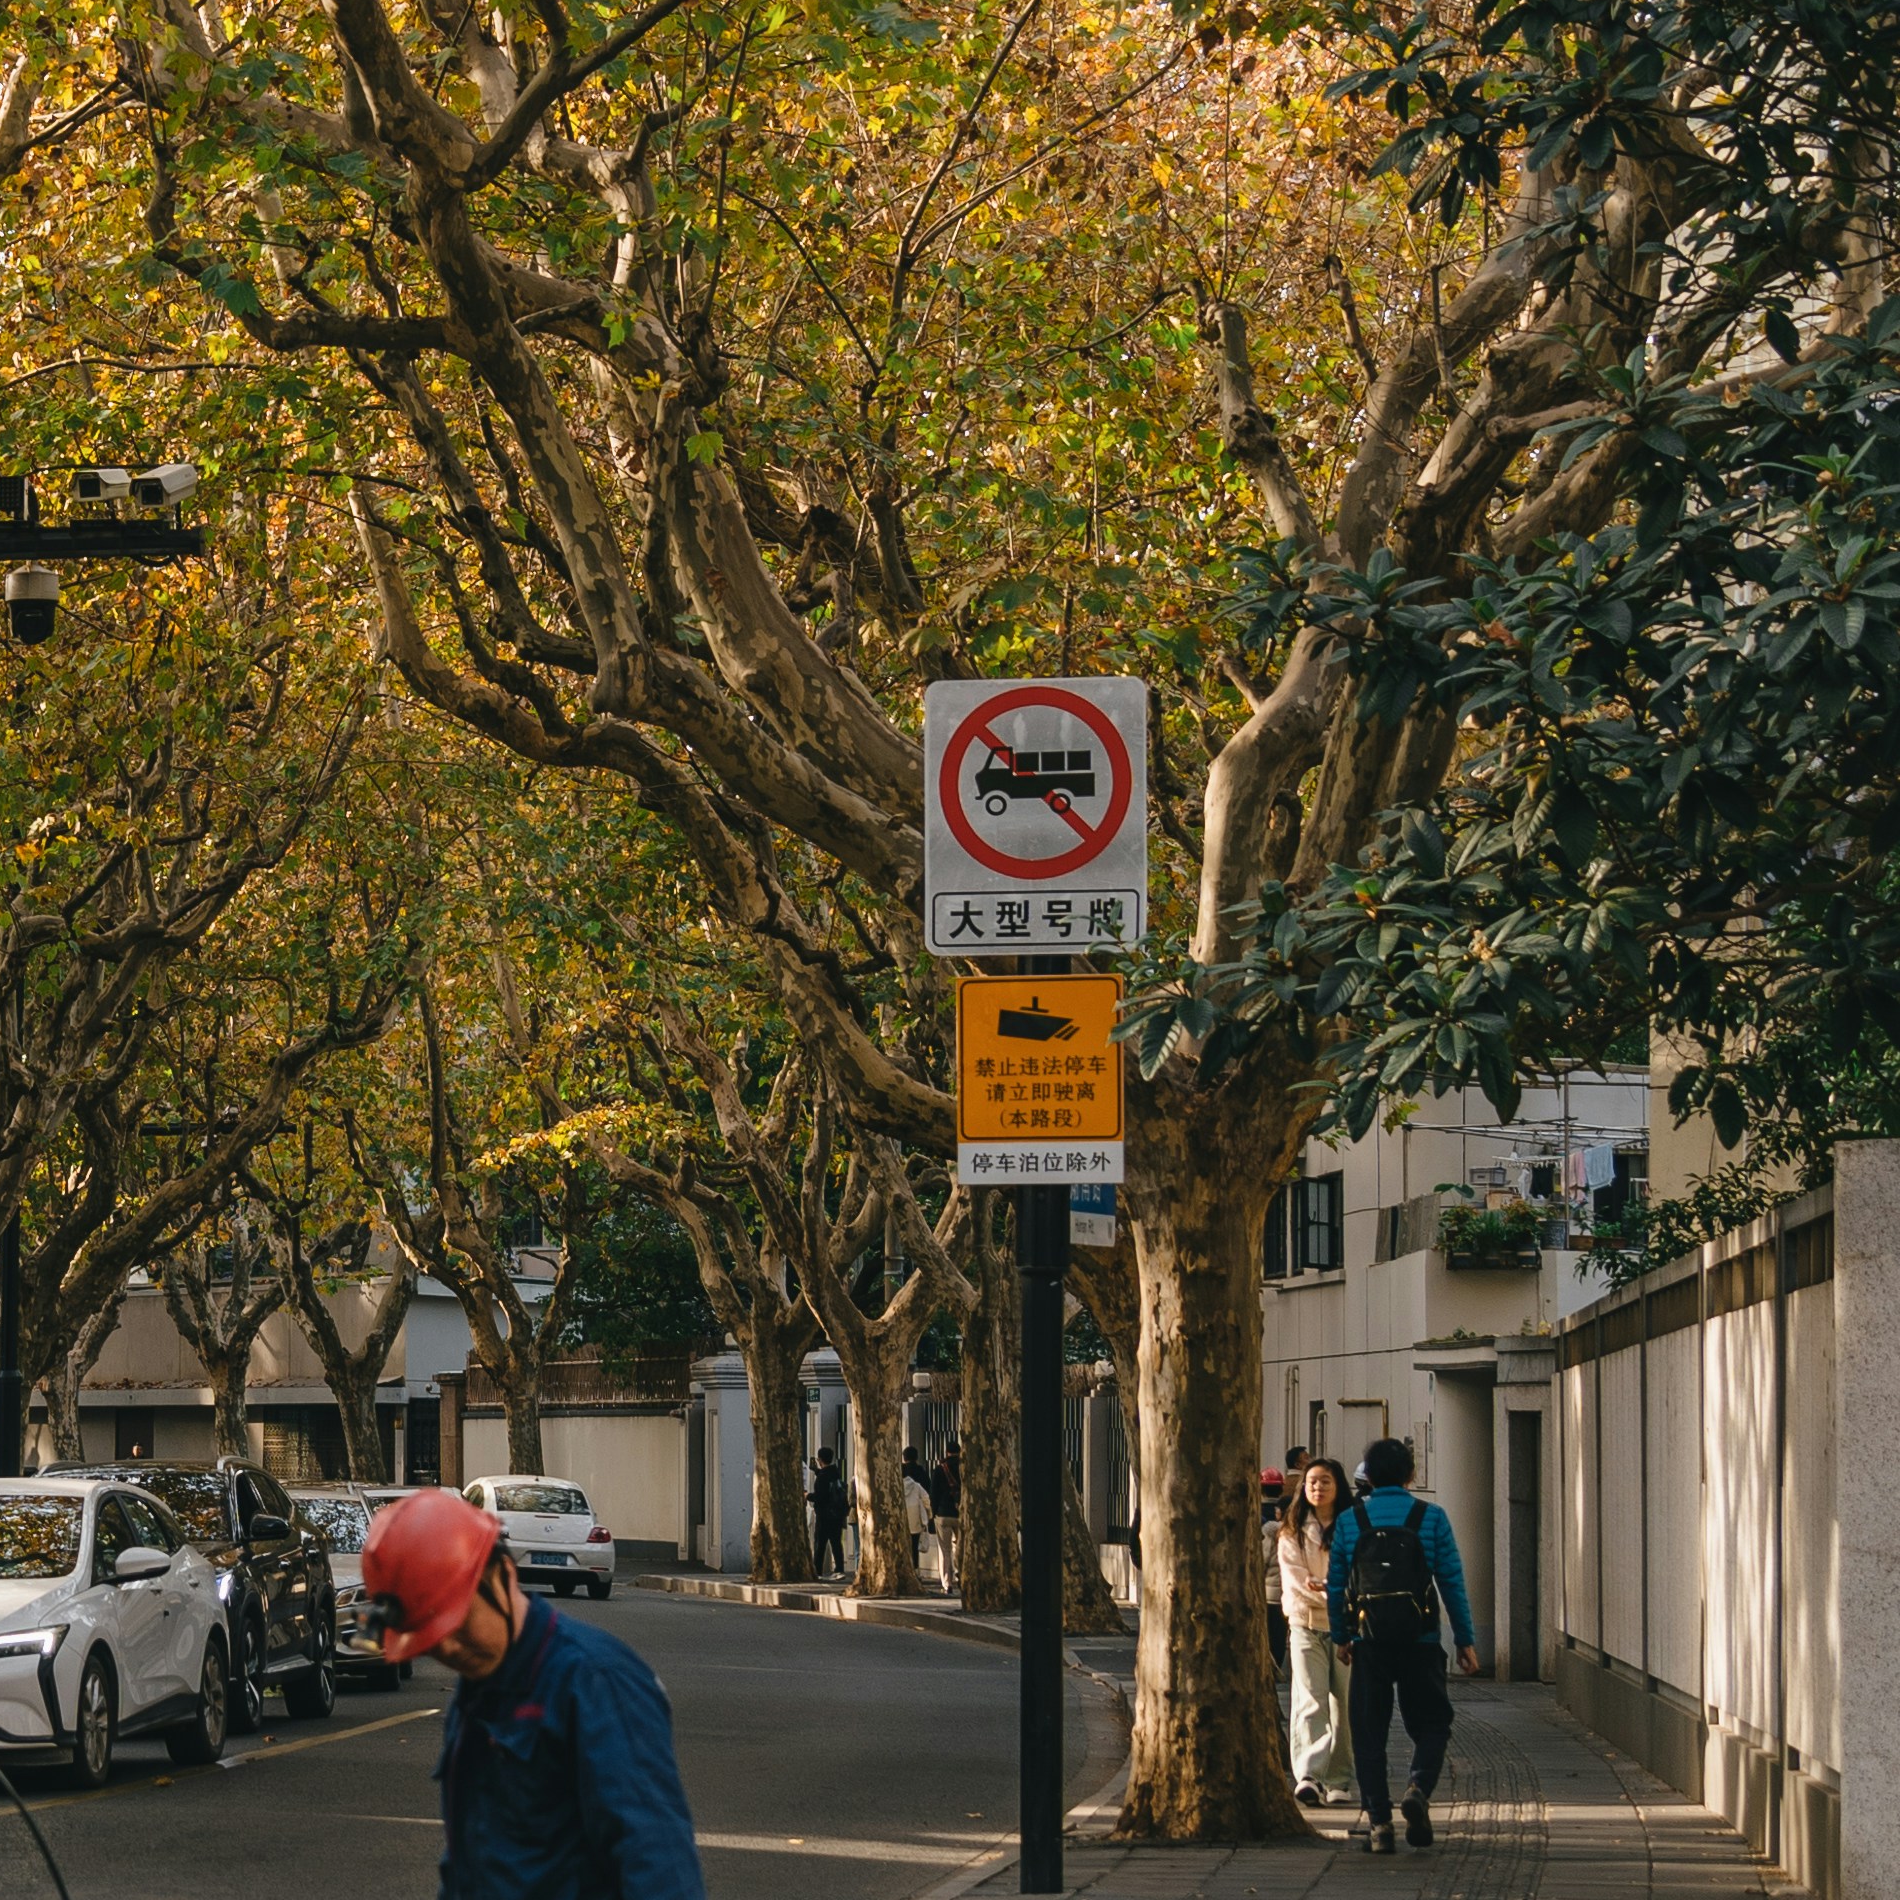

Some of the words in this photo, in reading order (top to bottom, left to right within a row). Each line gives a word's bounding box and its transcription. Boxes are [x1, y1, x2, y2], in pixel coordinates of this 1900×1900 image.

[975, 1054, 1107, 1078] 禁止违法停车
[985, 1081, 1096, 1103] 请立即驶离
[971, 1151, 1111, 1174] 停车泊位除外
